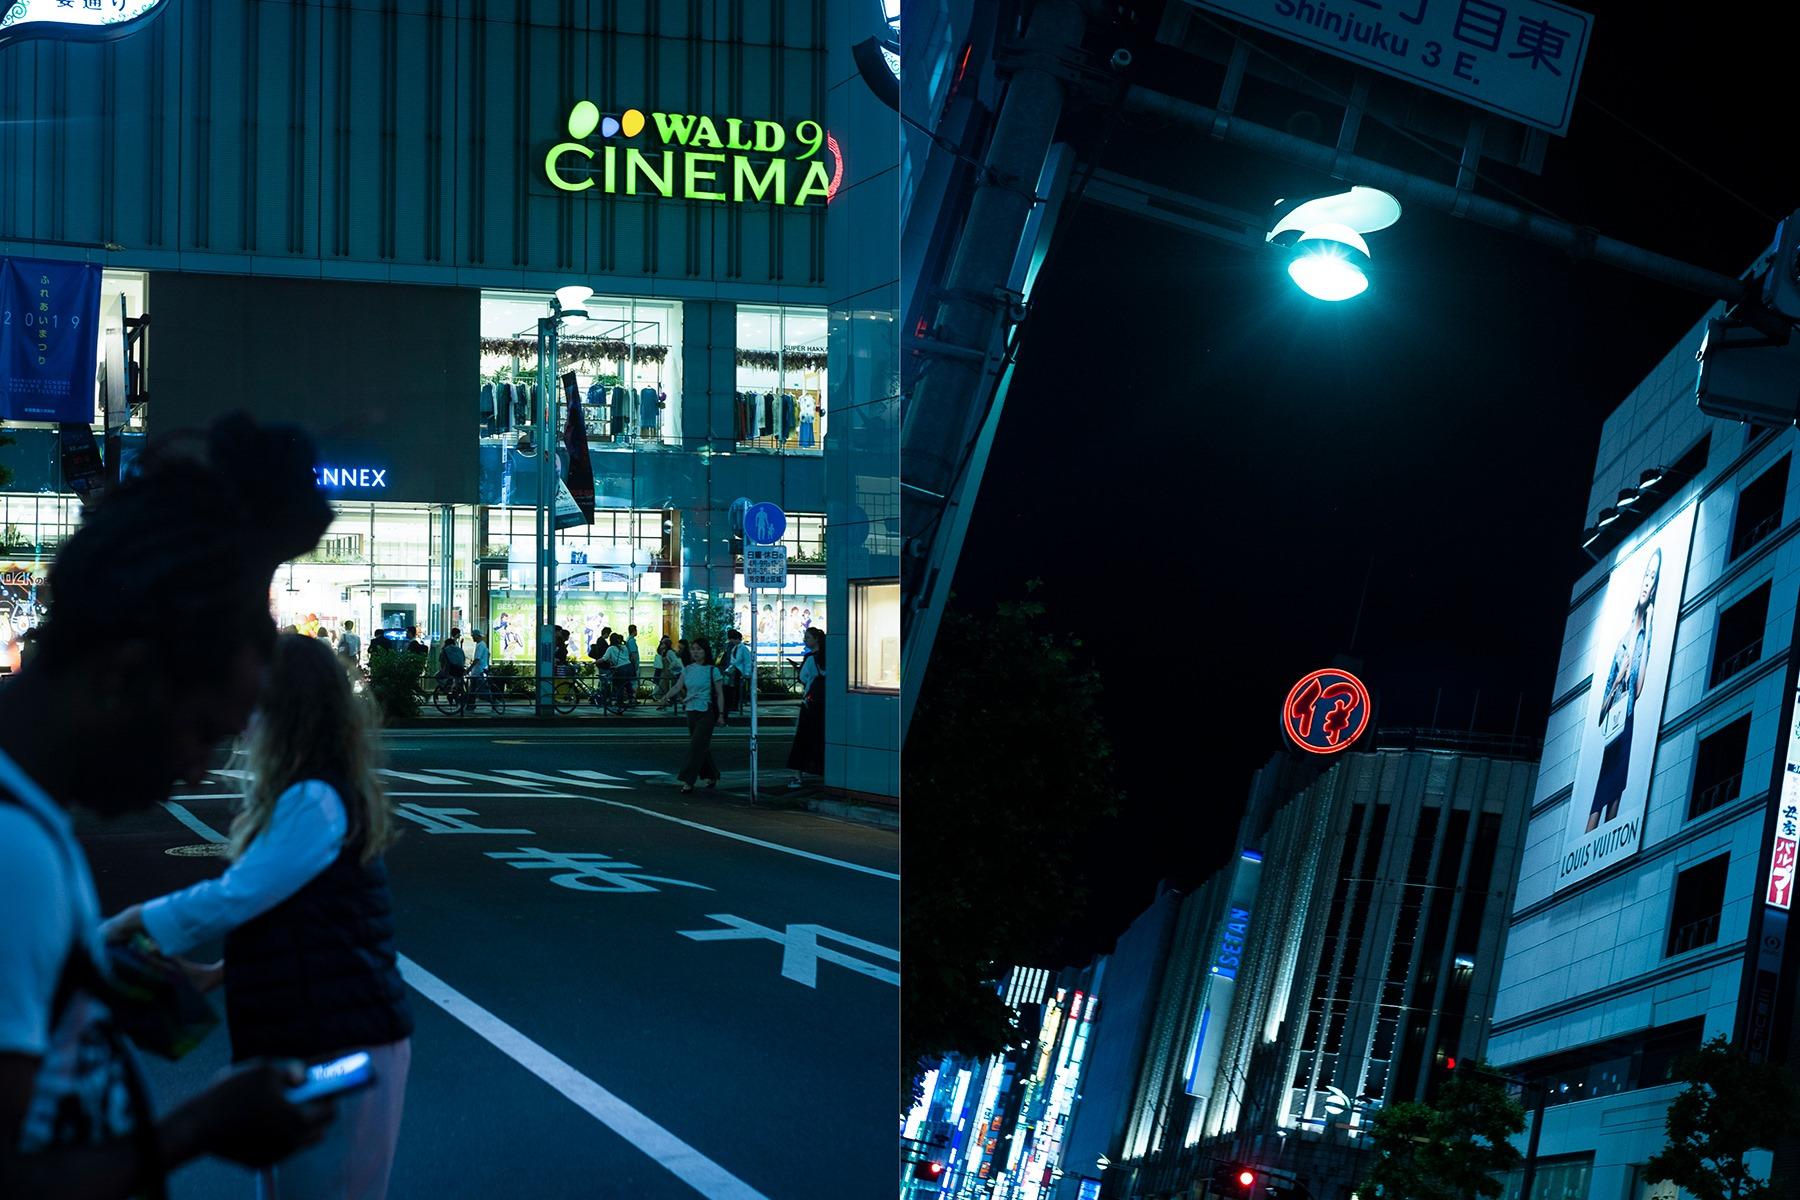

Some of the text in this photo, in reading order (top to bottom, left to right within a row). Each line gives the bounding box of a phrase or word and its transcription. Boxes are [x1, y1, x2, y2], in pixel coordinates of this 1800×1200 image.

[1274, 0, 1481, 85] Shinjuku 3 E.
[652, 112, 823, 160] WALD 9
[545, 142, 829, 206] CINEMA
[38, 275, 50, 365] ふれあいまつり
[1560, 817, 1639, 877] LOUIS VUITTON
